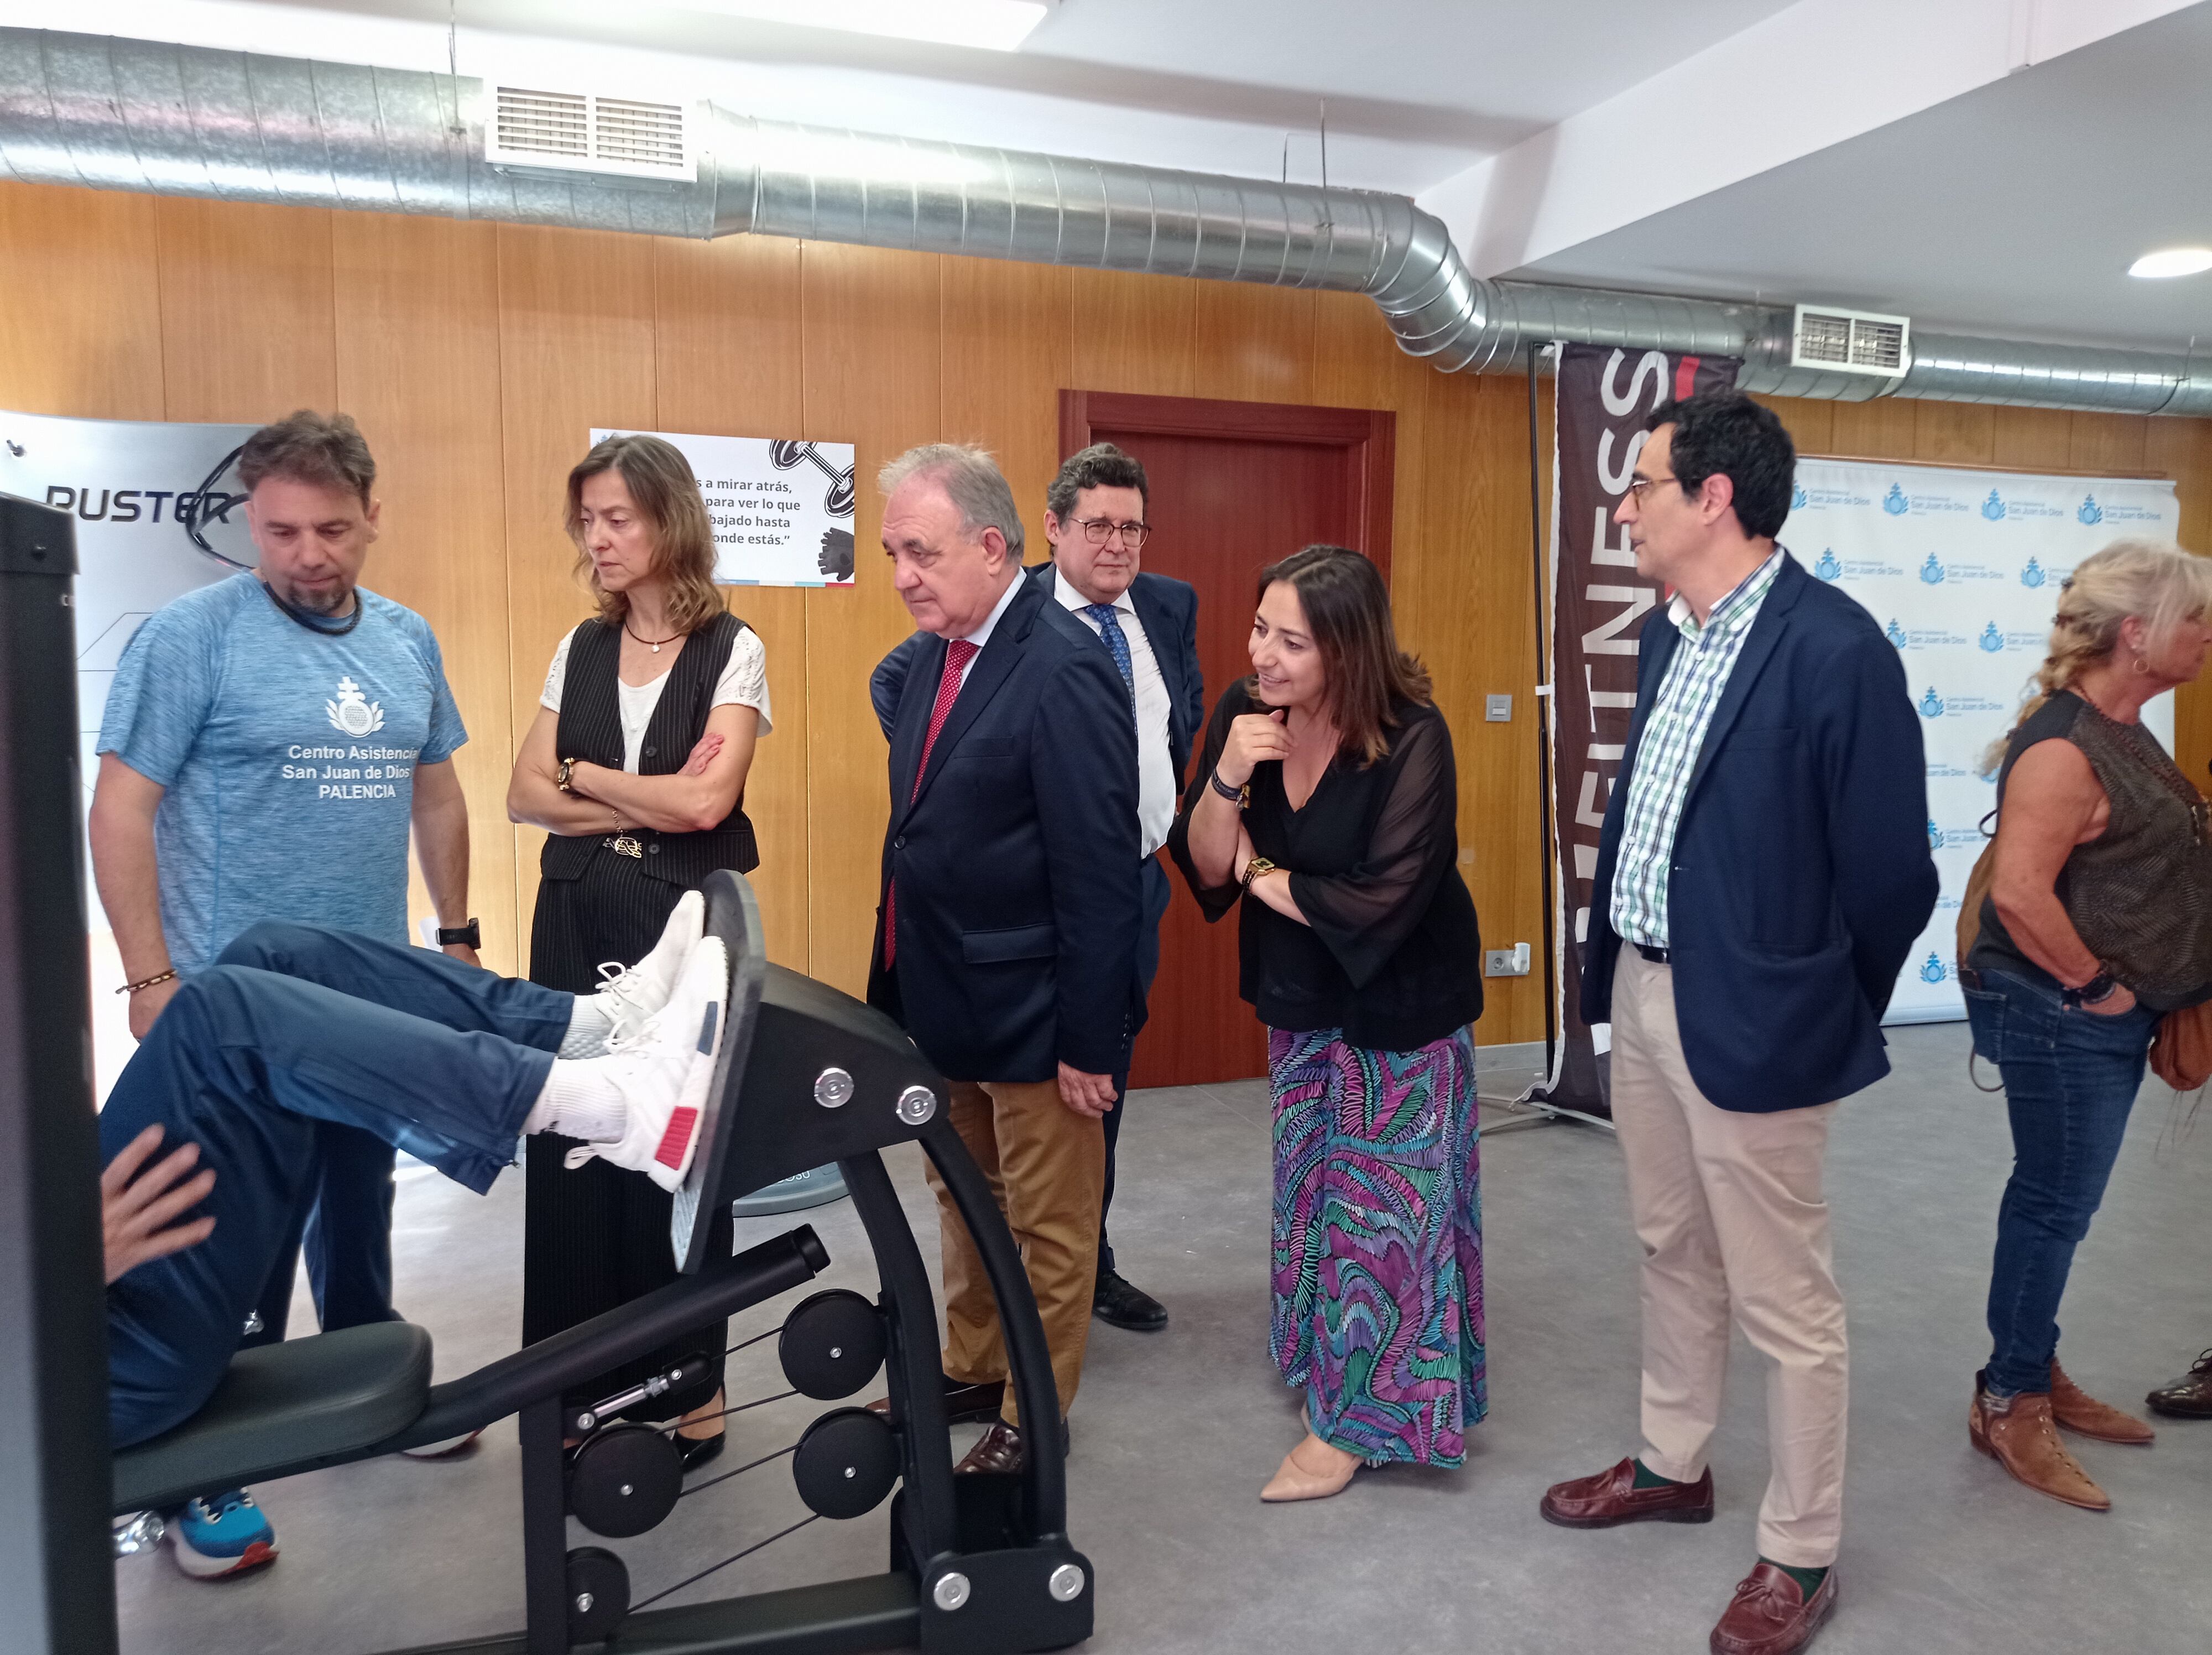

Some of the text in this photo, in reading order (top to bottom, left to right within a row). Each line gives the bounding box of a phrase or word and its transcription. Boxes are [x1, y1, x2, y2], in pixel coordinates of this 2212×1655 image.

[717, 479, 753, 490] mirar
[756, 481, 792, 494] atrás,
[706, 498, 801, 513] para ver lo que
[708, 514, 790, 528] bajado hasta
[712, 533, 744, 544] onde
[289, 745, 345, 759] Centro
[282, 764, 410, 779] San Juan de Dios
[319, 784, 397, 799] PALENCIA
